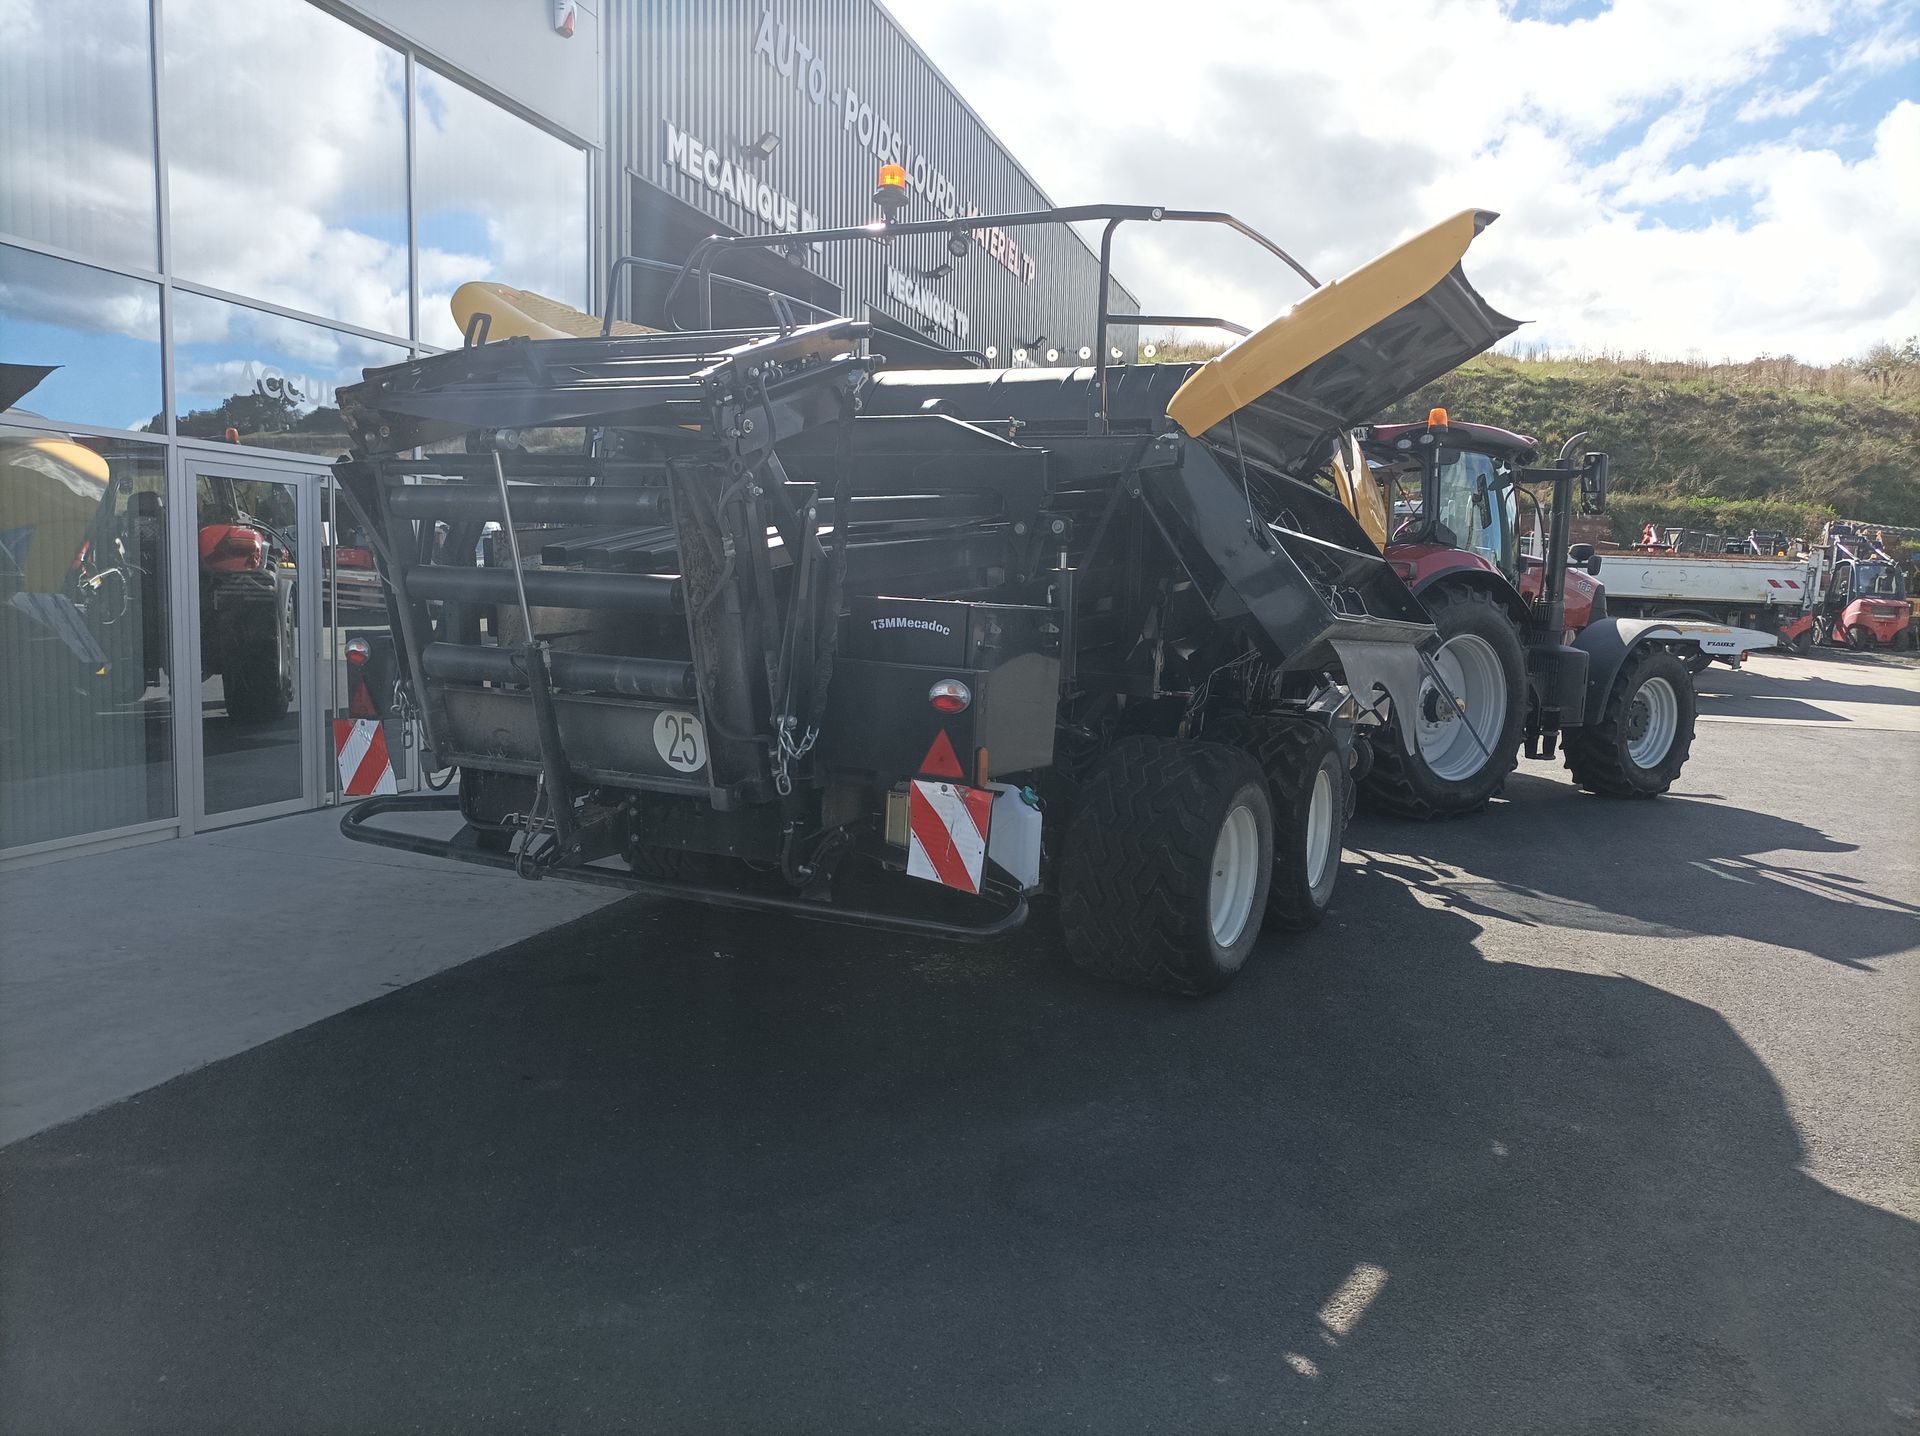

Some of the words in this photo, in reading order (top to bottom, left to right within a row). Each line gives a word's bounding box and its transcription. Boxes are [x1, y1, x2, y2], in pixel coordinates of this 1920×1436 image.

[755, 10, 826, 104] AUTO
[844, 87, 902, 166] POIDS
[905, 144, 955, 219] LOURD
[667, 121, 799, 233] MECANIQUE
[886, 264, 955, 334] MECANIQUE
[956, 306, 968, 340] TP
[665, 714, 697, 765] 25
